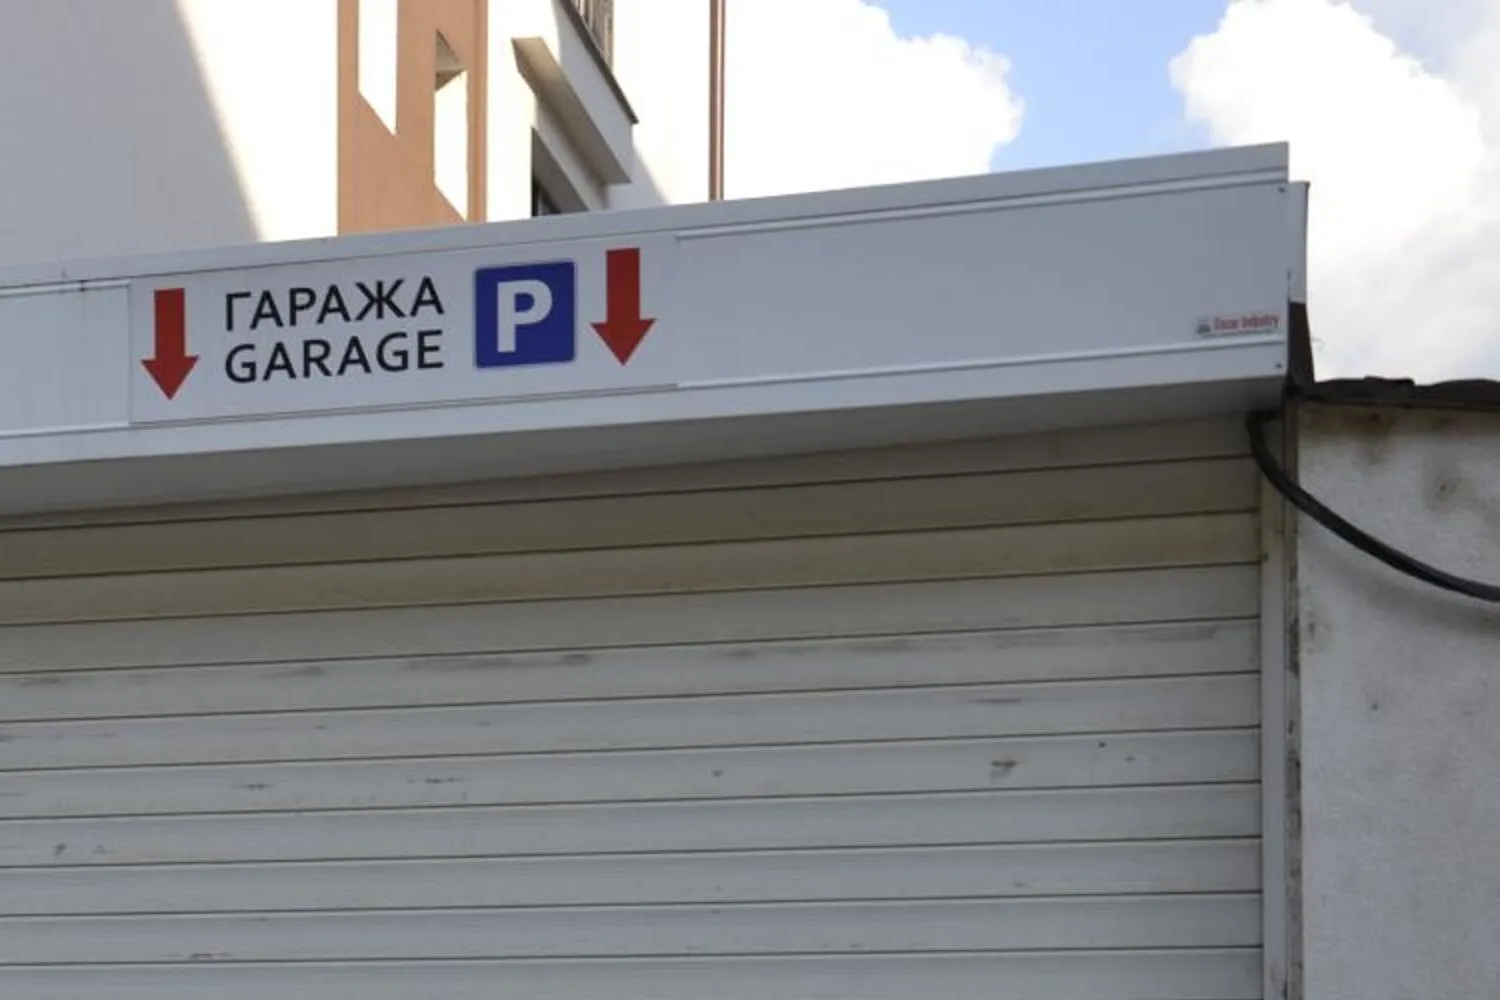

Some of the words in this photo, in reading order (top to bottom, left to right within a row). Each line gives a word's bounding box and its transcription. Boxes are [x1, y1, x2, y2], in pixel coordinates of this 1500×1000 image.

[224, 276, 445, 332] ГАРАЖА
[497, 279, 553, 354] P
[224, 329, 445, 384] GARAGE
